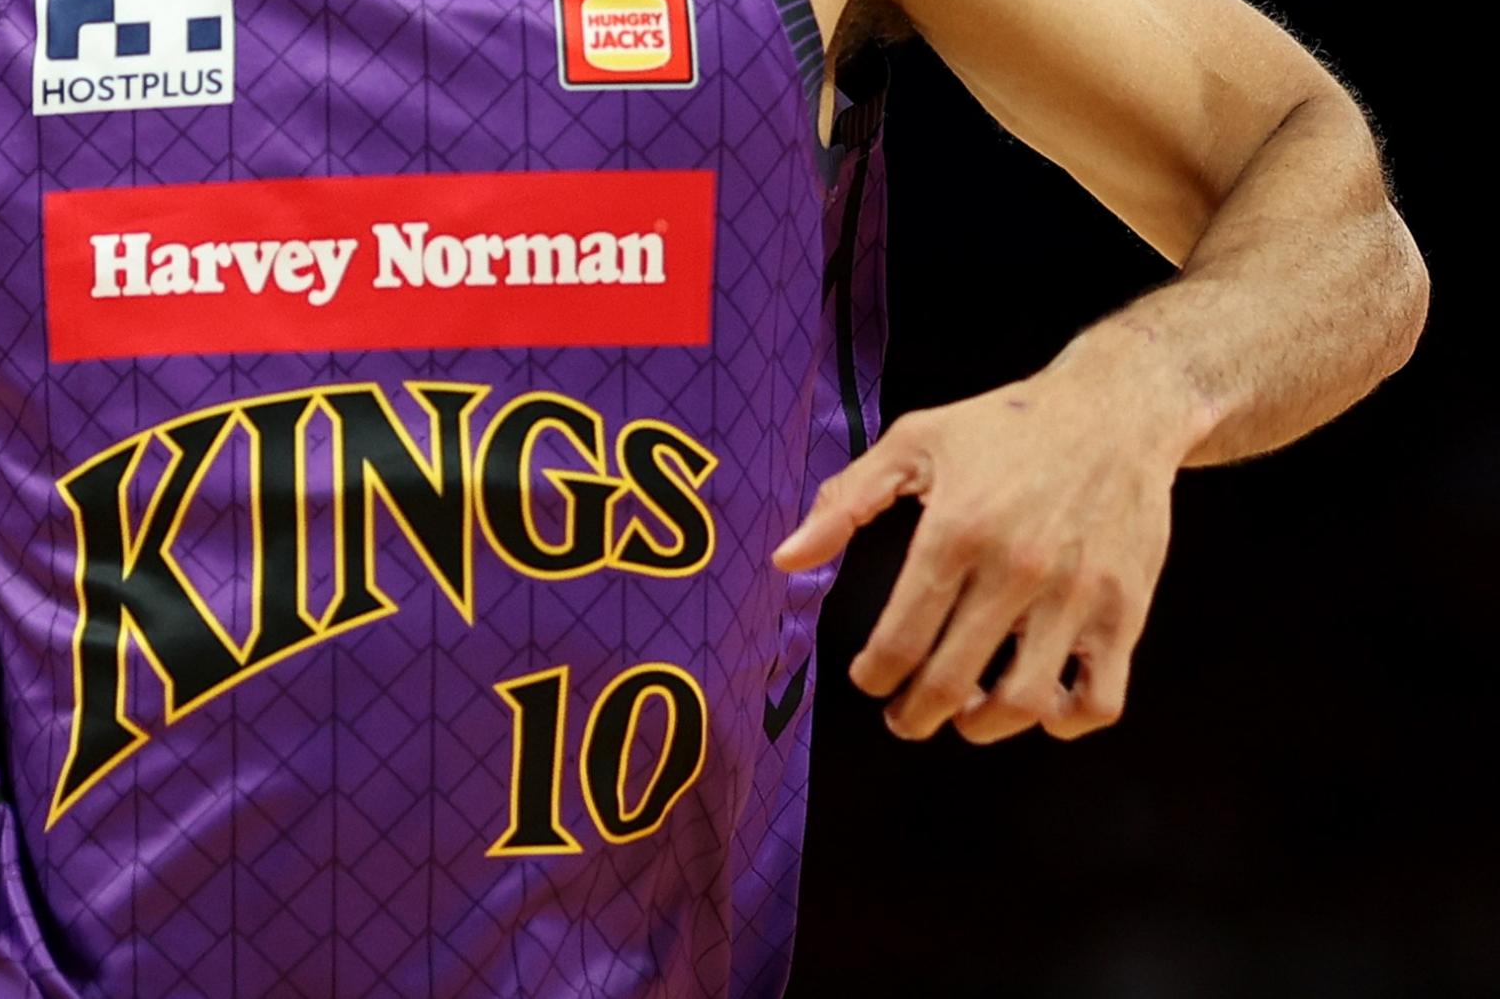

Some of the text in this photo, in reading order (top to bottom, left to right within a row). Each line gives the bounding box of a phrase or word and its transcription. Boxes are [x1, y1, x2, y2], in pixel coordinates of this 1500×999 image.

[587, 12, 663, 29] HUNGRY
[42, 68, 224, 106] HOSTPLUS
[90, 221, 666, 306] Harvey Norman
[45, 380, 719, 832] KINGS
[485, 661, 707, 857] 10
